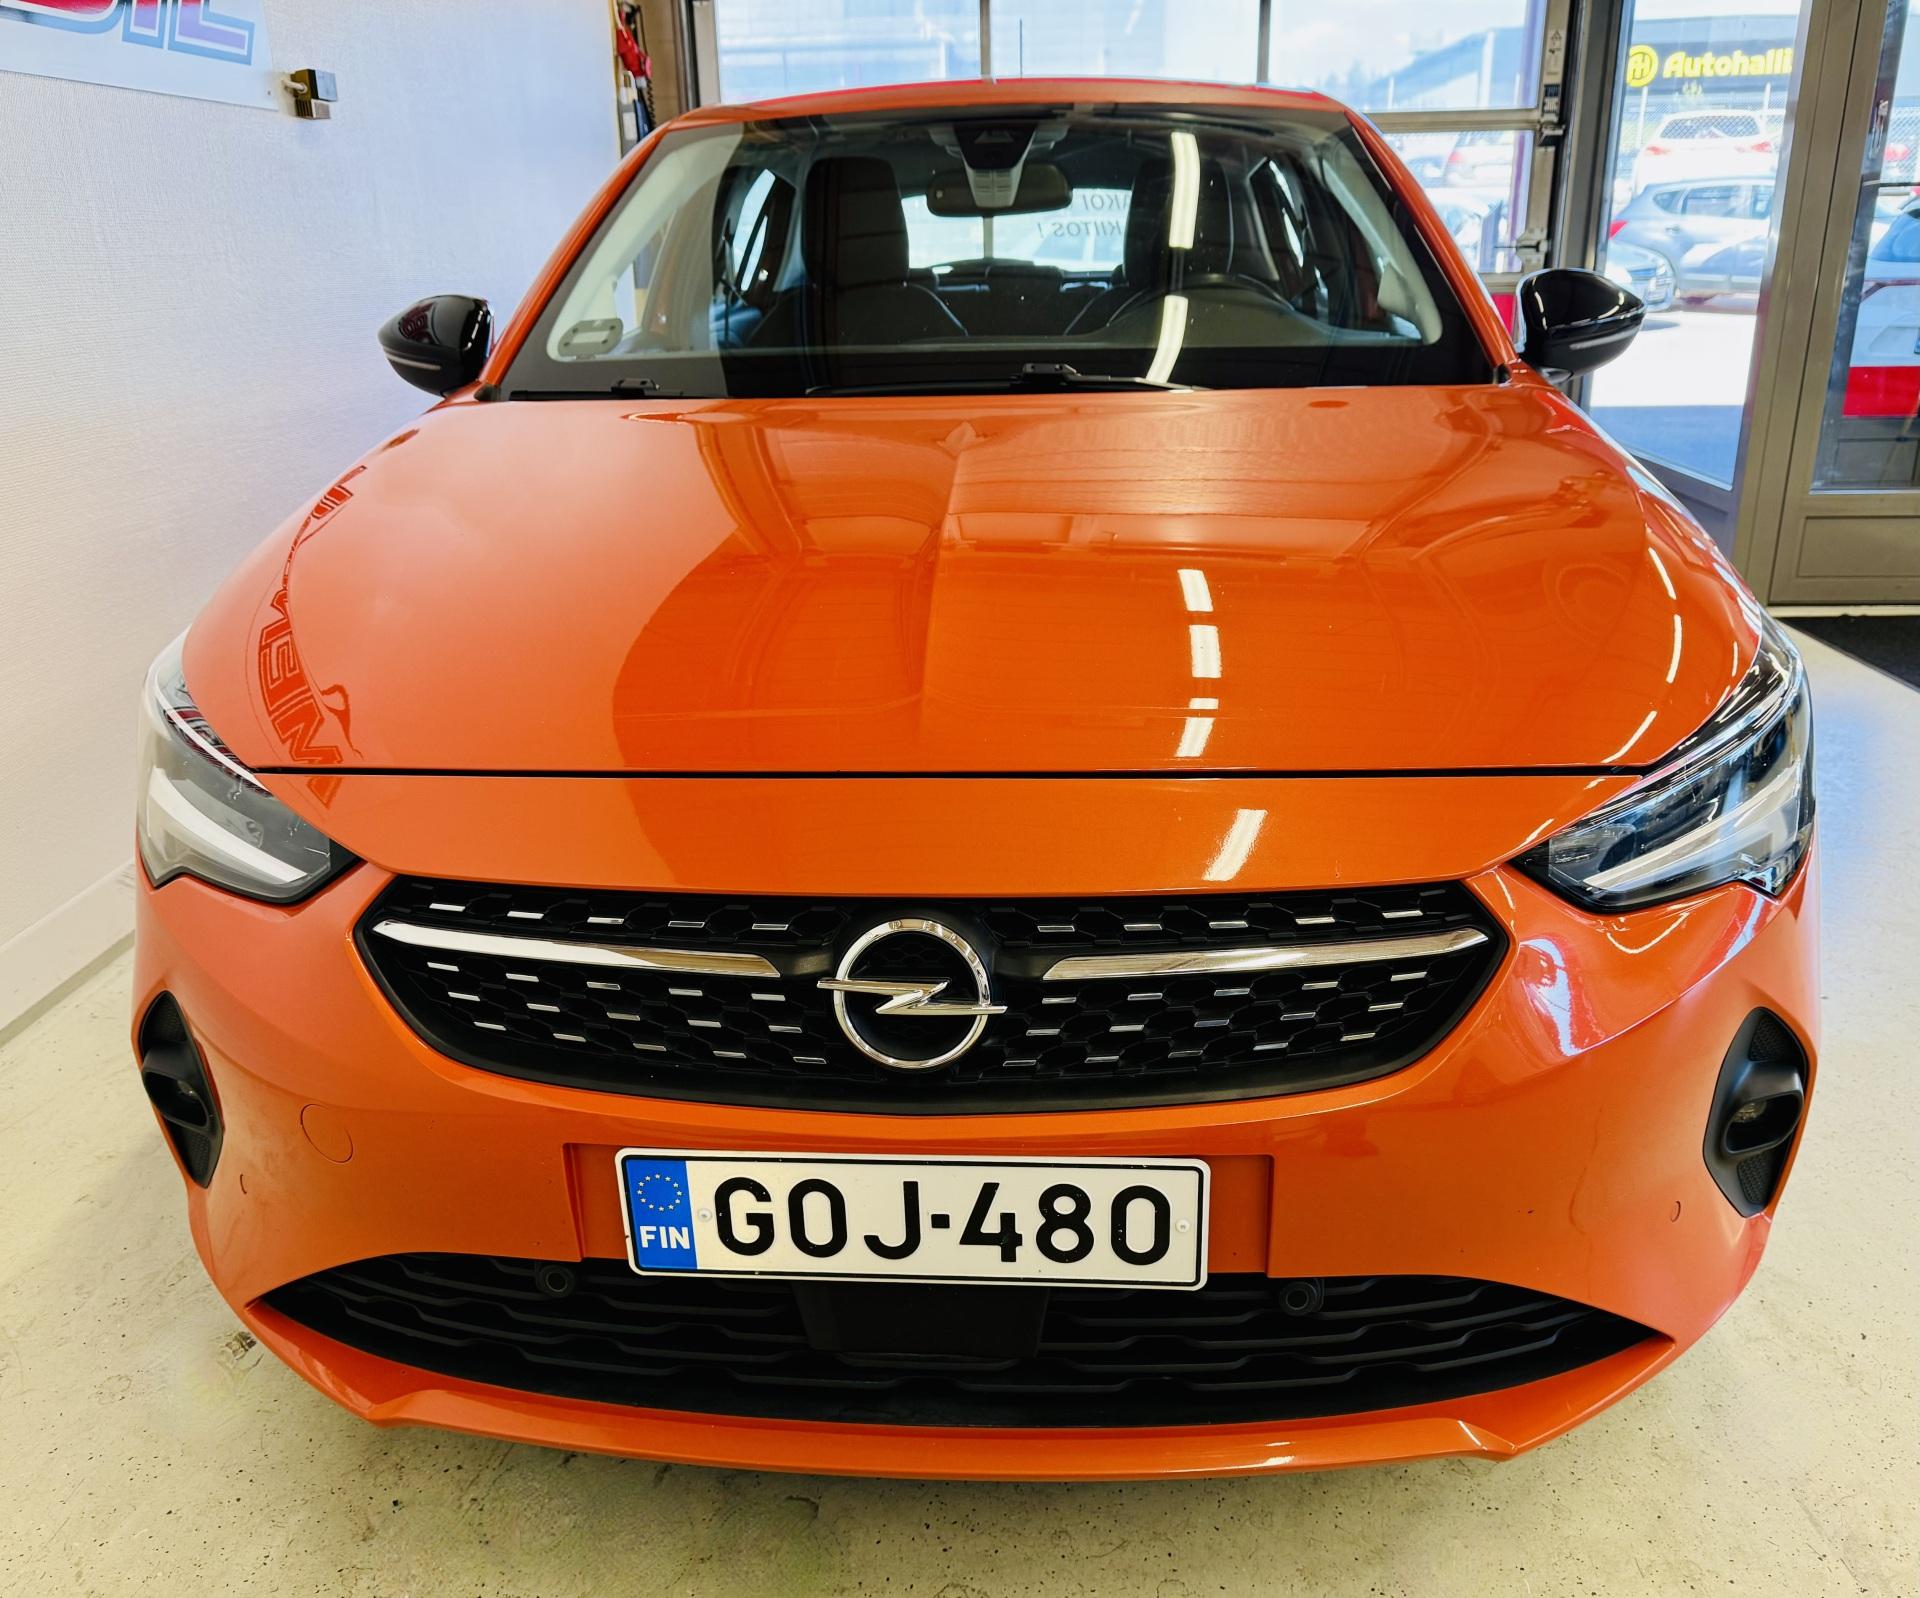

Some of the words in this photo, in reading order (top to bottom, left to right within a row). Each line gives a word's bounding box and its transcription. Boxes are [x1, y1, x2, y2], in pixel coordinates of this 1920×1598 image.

[1662, 48, 1793, 78] Autohalli
[714, 1176, 1171, 1266] GOJ-480
[640, 1226, 690, 1249] FIN
